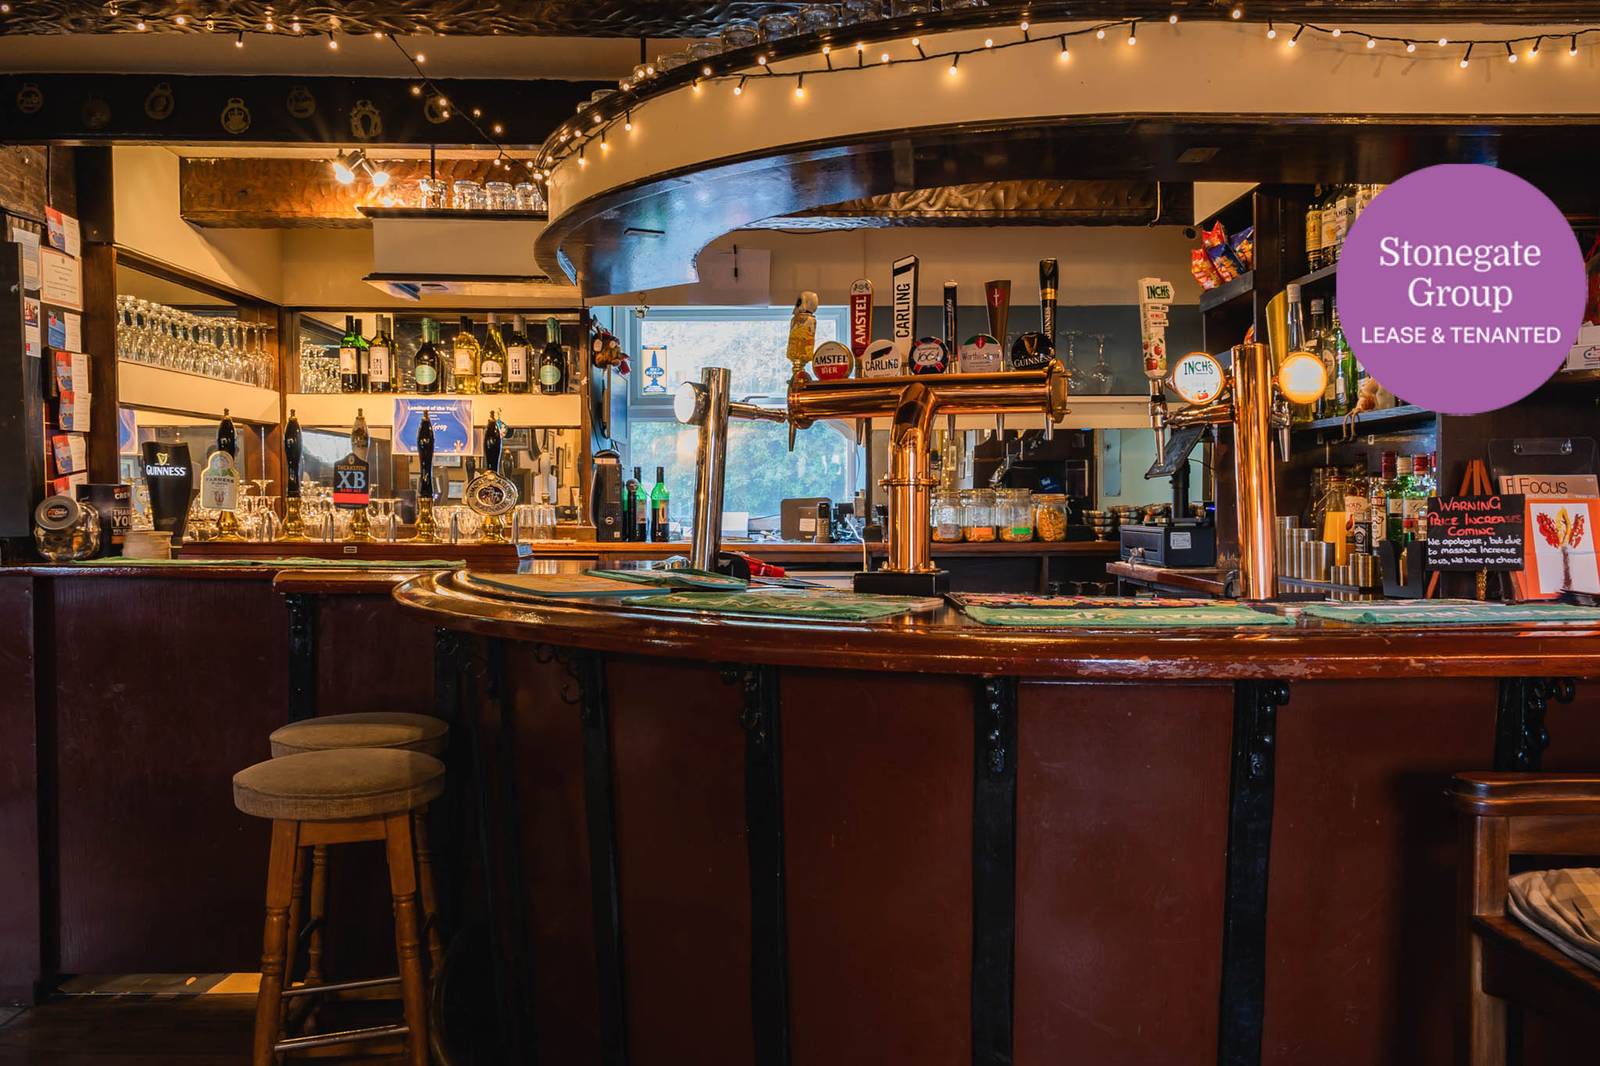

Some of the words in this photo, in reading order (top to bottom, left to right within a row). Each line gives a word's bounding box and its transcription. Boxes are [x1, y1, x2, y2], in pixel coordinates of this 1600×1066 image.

[896, 282, 911, 339] CARLING
[855, 296, 867, 345] AMSTEL
[814, 354, 849, 365] AMSTEL
[865, 358, 899, 371] CARLING
[821, 366, 838, 374] BIER
[146, 464, 187, 477] GUINNESS
[336, 471, 366, 489] XB
[1437, 496, 1502, 512] WARNING
[1427, 512, 1459, 526] PRICE
[1427, 538, 1440, 546] We
[1489, 537, 1504, 545] but
[1504, 535, 1522, 545] due
[1428, 547, 1438, 555] to
[1465, 556, 1483, 564] have
[1496, 556, 1522, 564] choice
